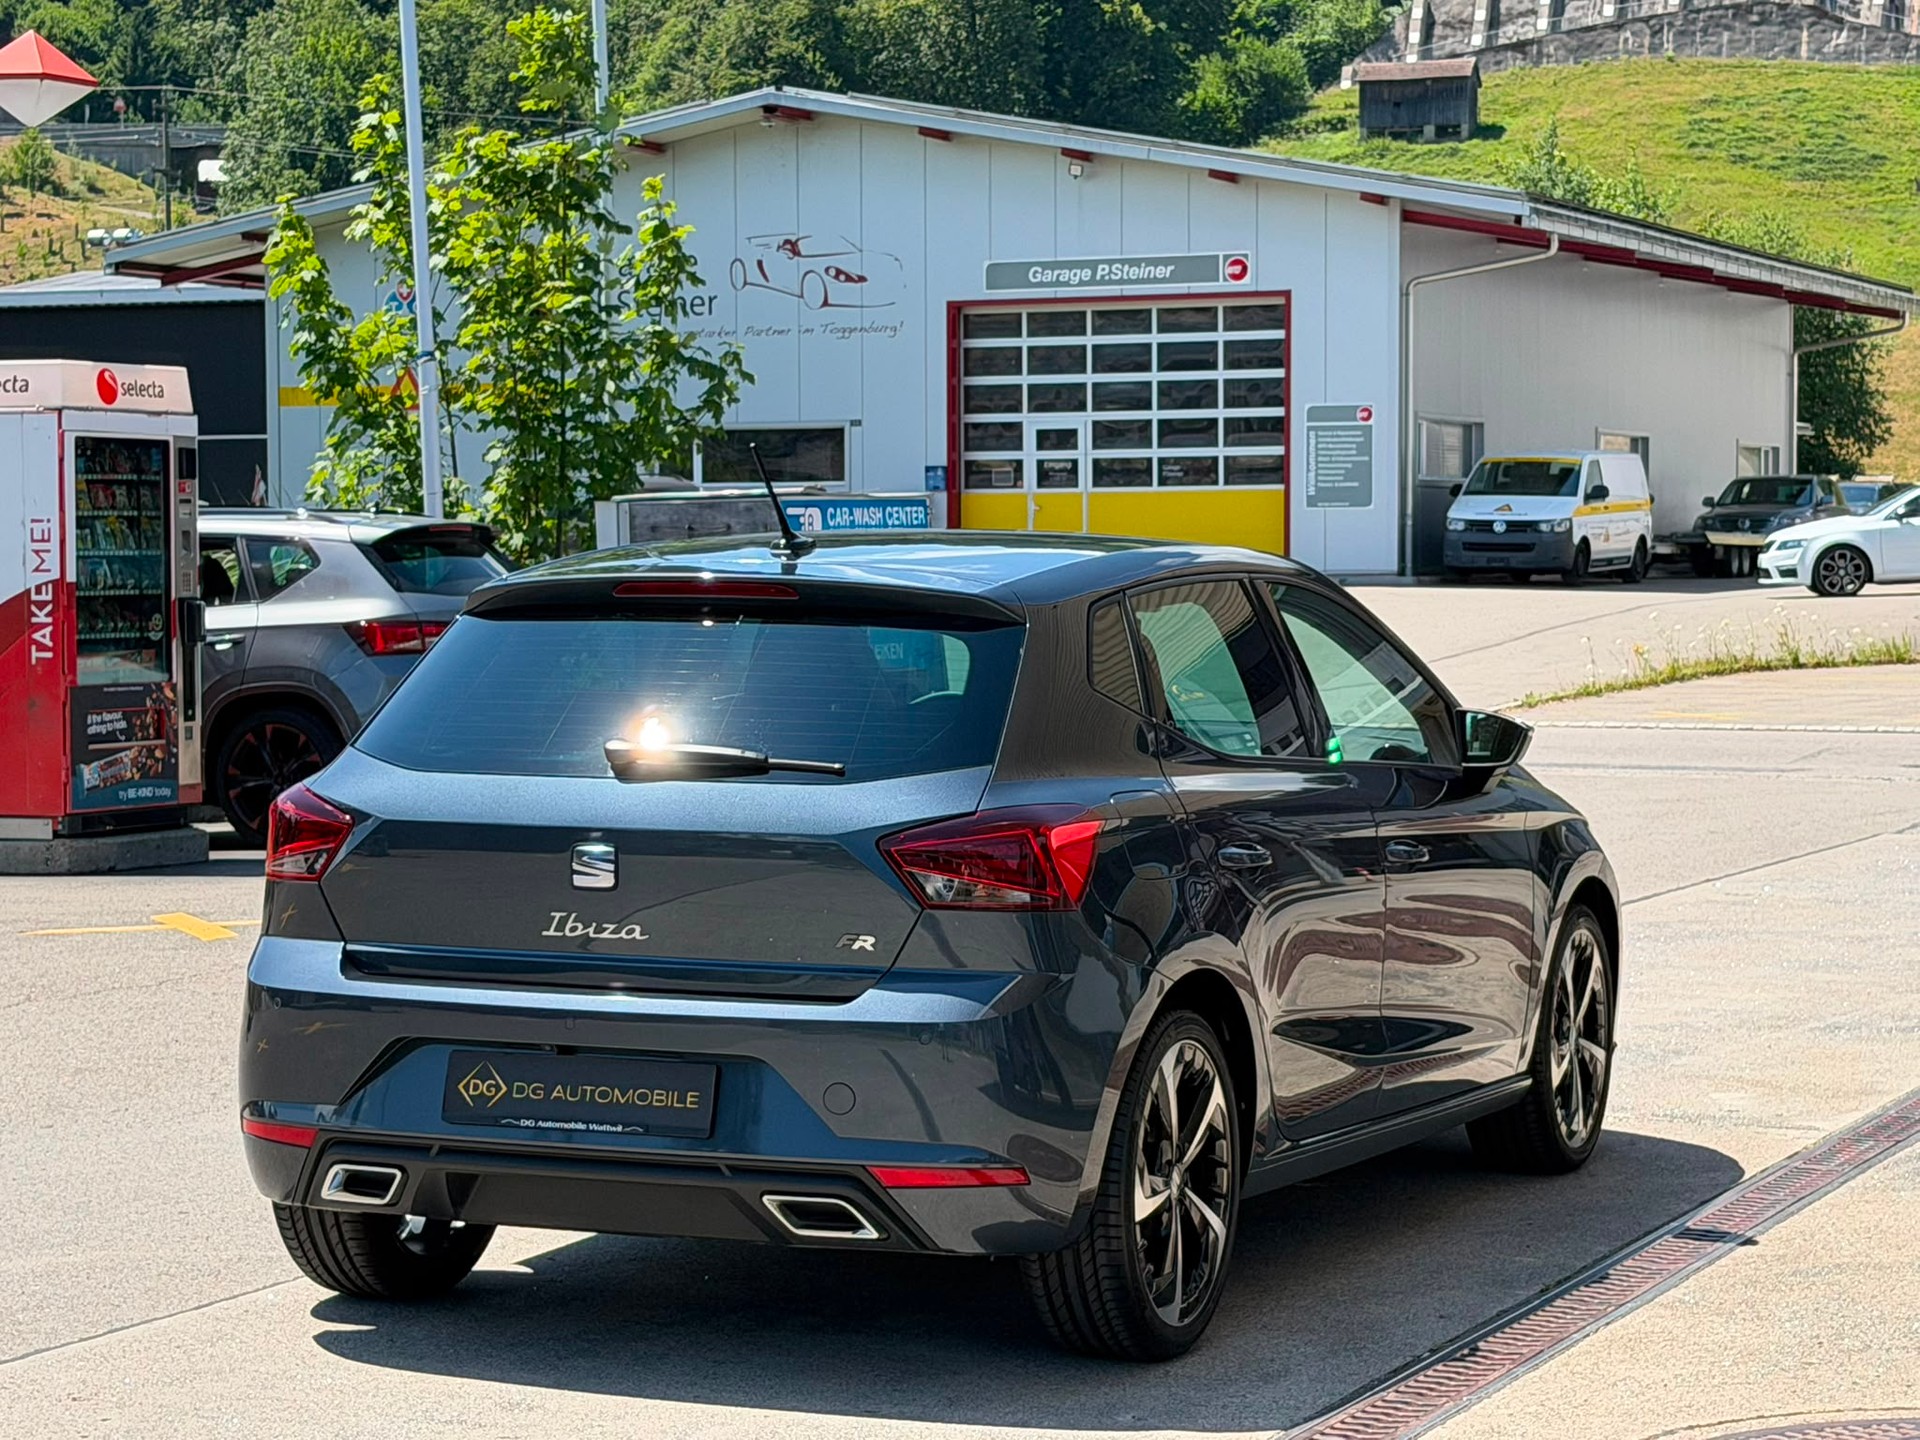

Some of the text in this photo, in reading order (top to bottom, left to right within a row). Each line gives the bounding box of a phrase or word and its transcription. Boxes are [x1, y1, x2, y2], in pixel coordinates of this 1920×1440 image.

[1028, 263, 1175, 285] Garage P.Steiner
[743, 325, 792, 337] Partner
[820, 320, 904, 340] Toggenburg!
[120, 379, 165, 398] selecta
[827, 506, 926, 527] CAR-WASH CENTER
[30, 517, 54, 666] TAKE ME!
[118, 790, 127, 802] try
[541, 912, 650, 940] Ibiza
[835, 934, 877, 951] FR
[468, 1079, 497, 1096] DG
[512, 1081, 700, 1109] DG AUTOMOBILE
[520, 1119, 623, 1132] DG Automobile Wattwil
